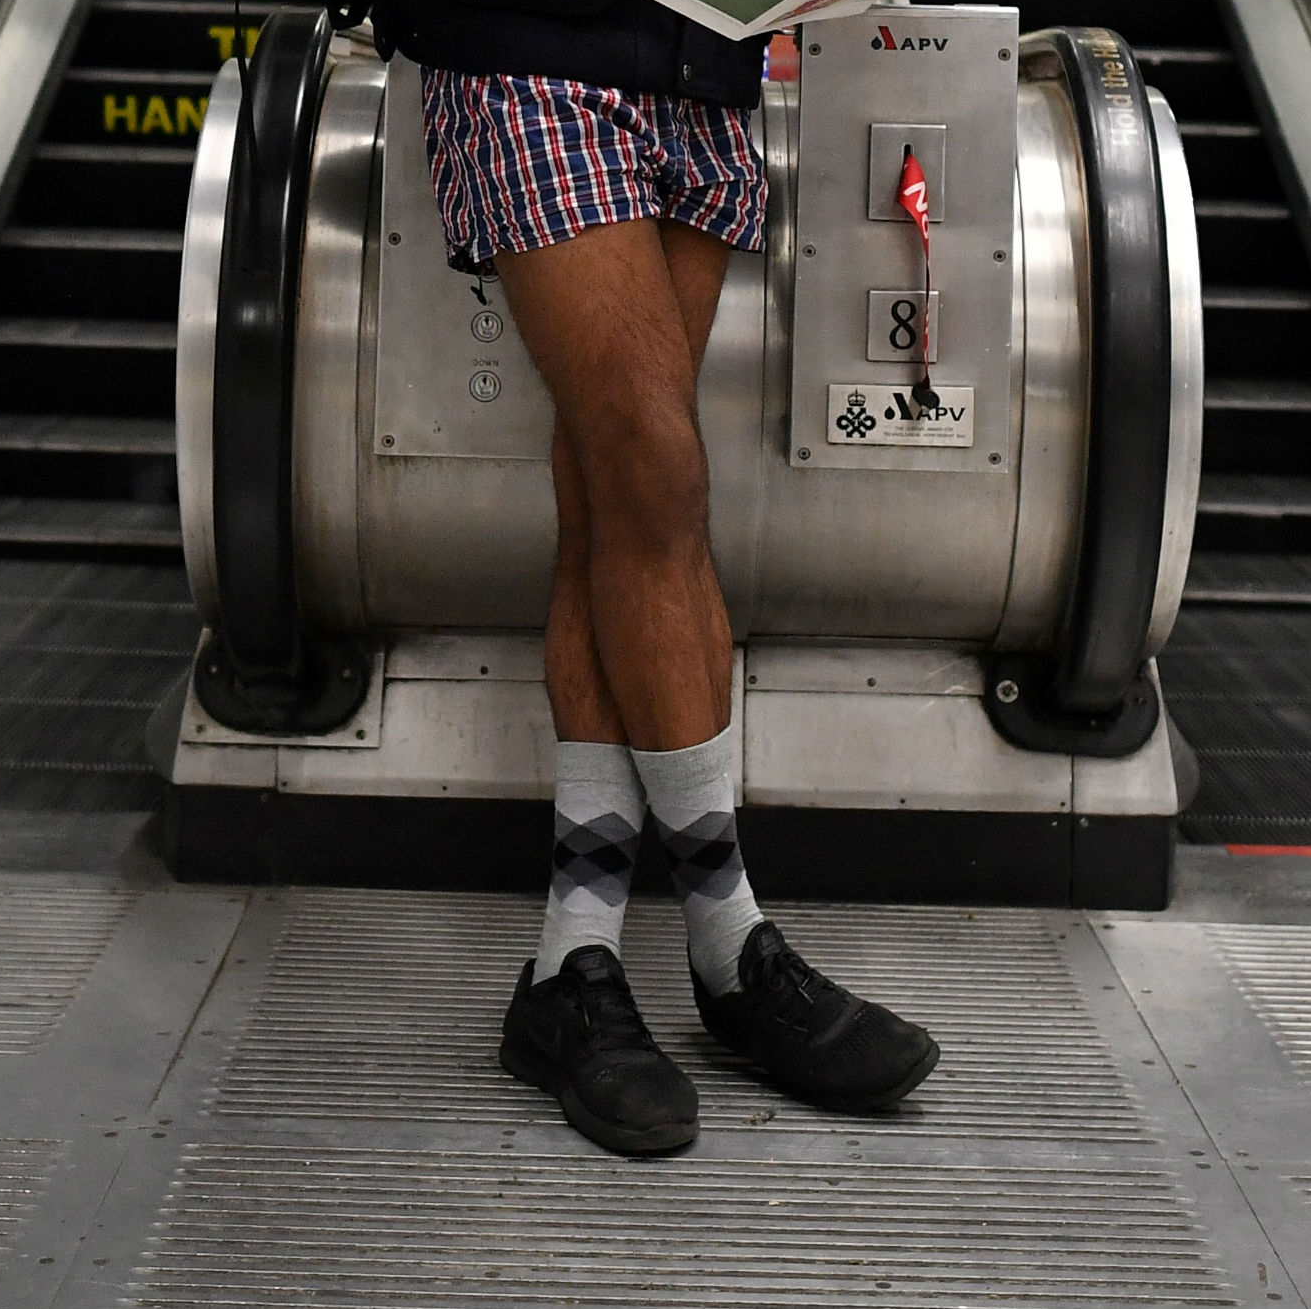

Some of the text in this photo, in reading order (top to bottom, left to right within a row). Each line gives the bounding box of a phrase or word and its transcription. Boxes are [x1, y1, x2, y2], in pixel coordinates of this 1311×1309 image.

[900, 37, 949, 52] APV
[1100, 61, 1129, 88] the
[1105, 94, 1139, 146] Hold
[889, 299, 917, 350] 8
[472, 358, 499, 367] DOWN
